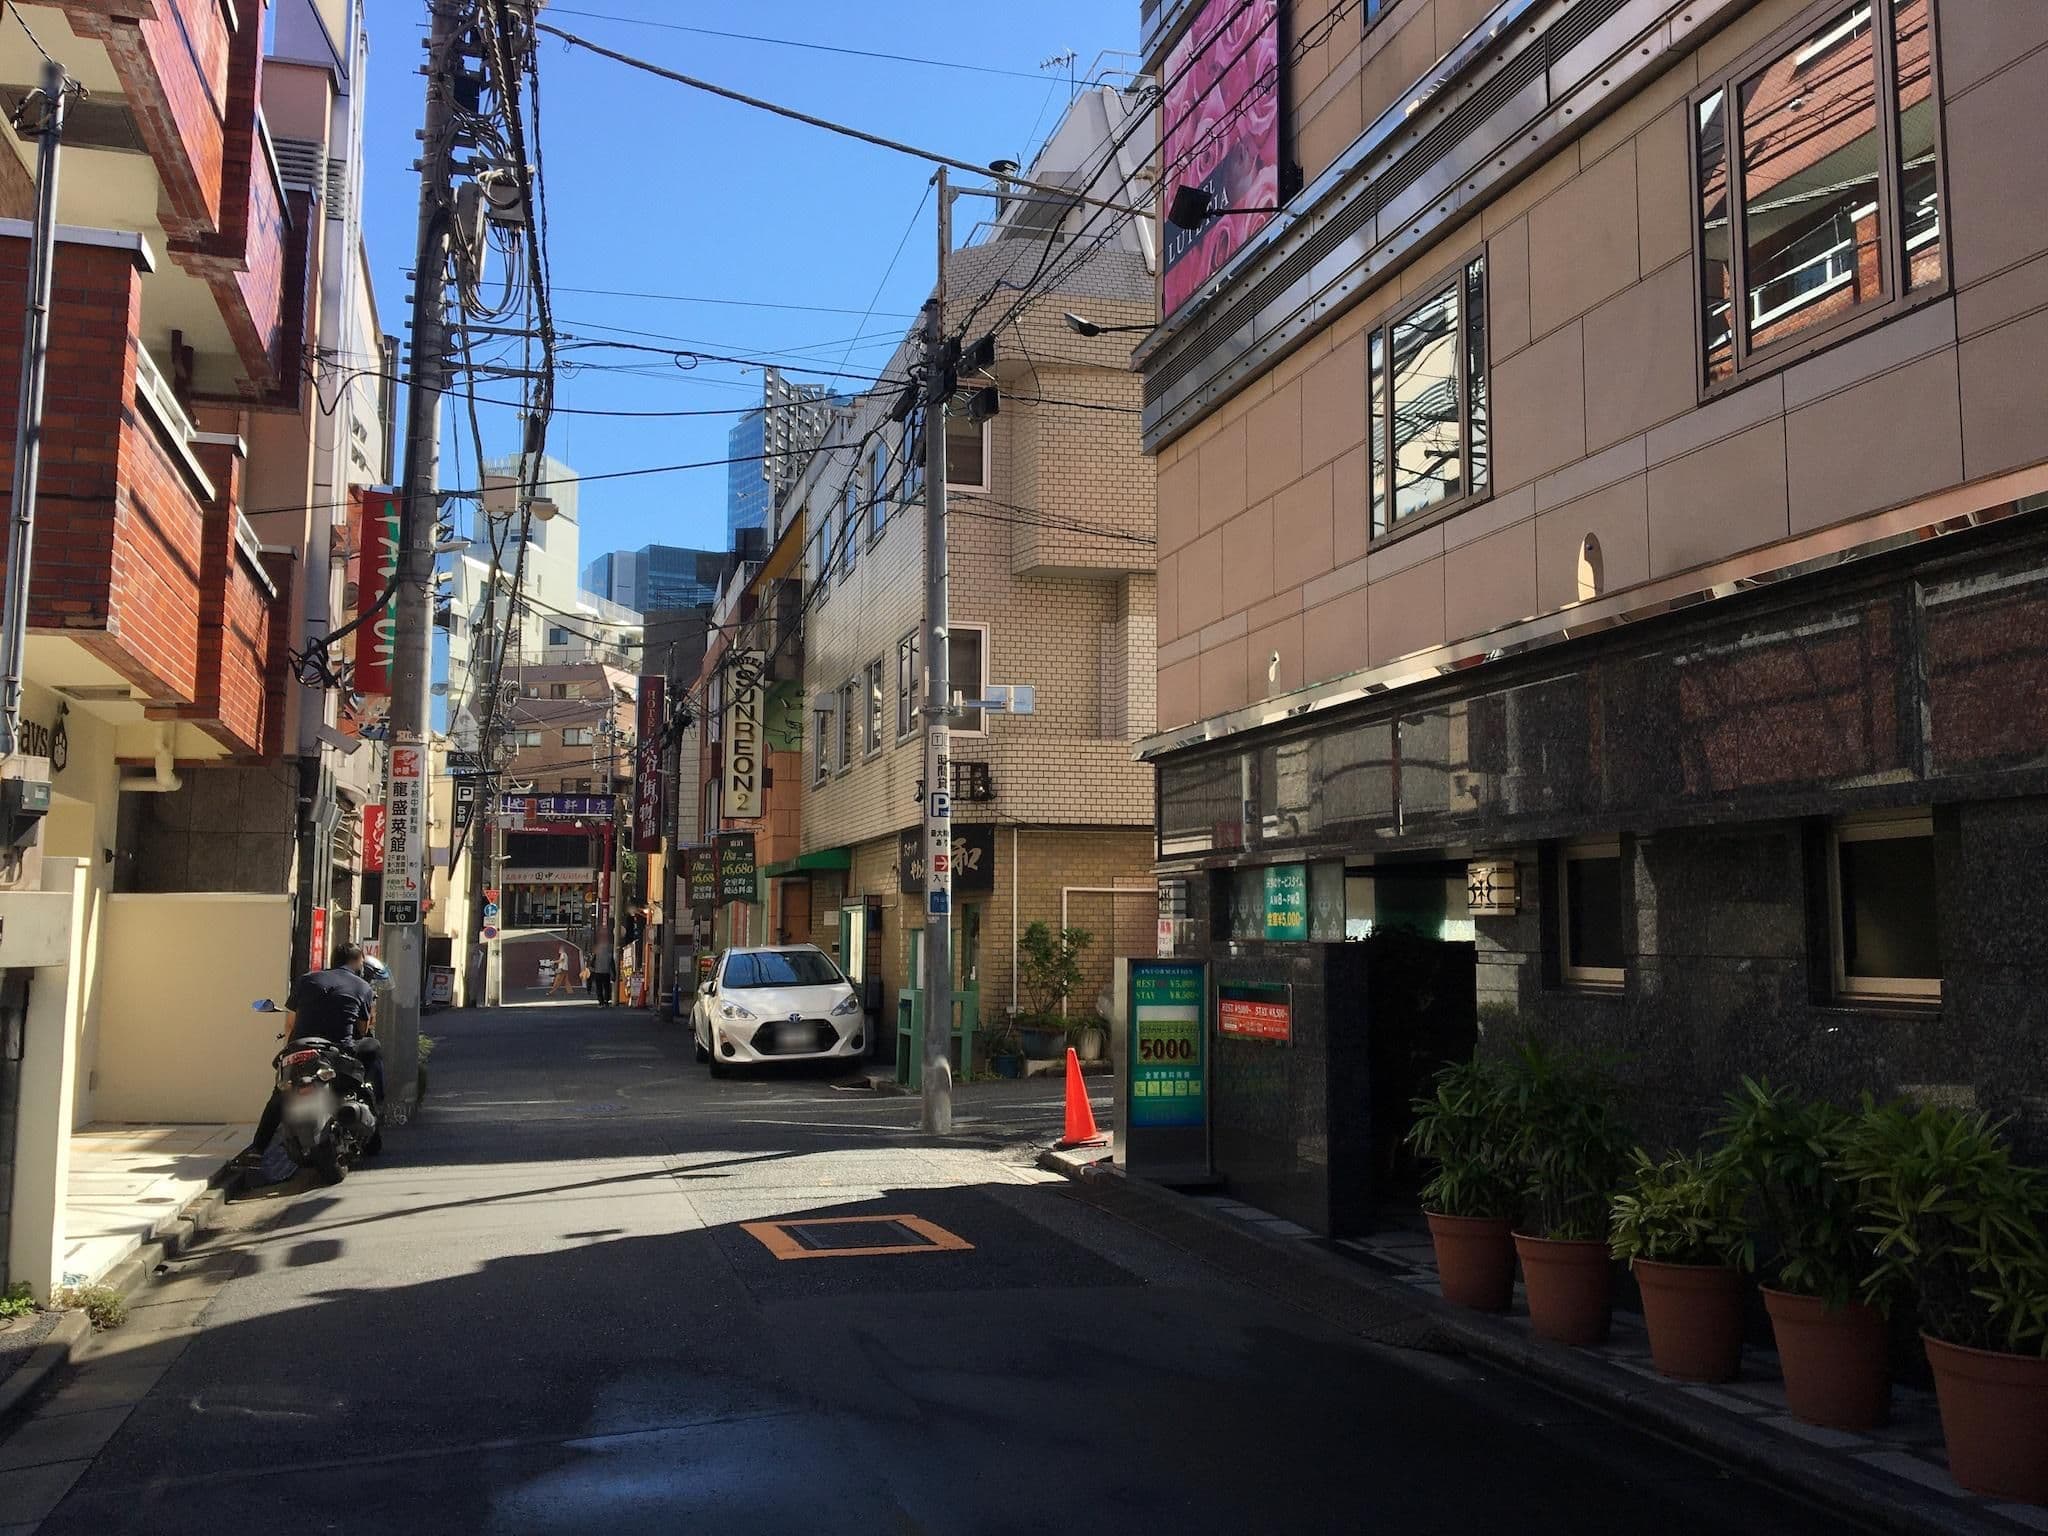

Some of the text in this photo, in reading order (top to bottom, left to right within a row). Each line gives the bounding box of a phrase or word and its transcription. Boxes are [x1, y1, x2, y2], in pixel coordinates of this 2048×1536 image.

[390, 781, 408, 853] 龍盛菜館
[736, 794, 749, 811] 2
